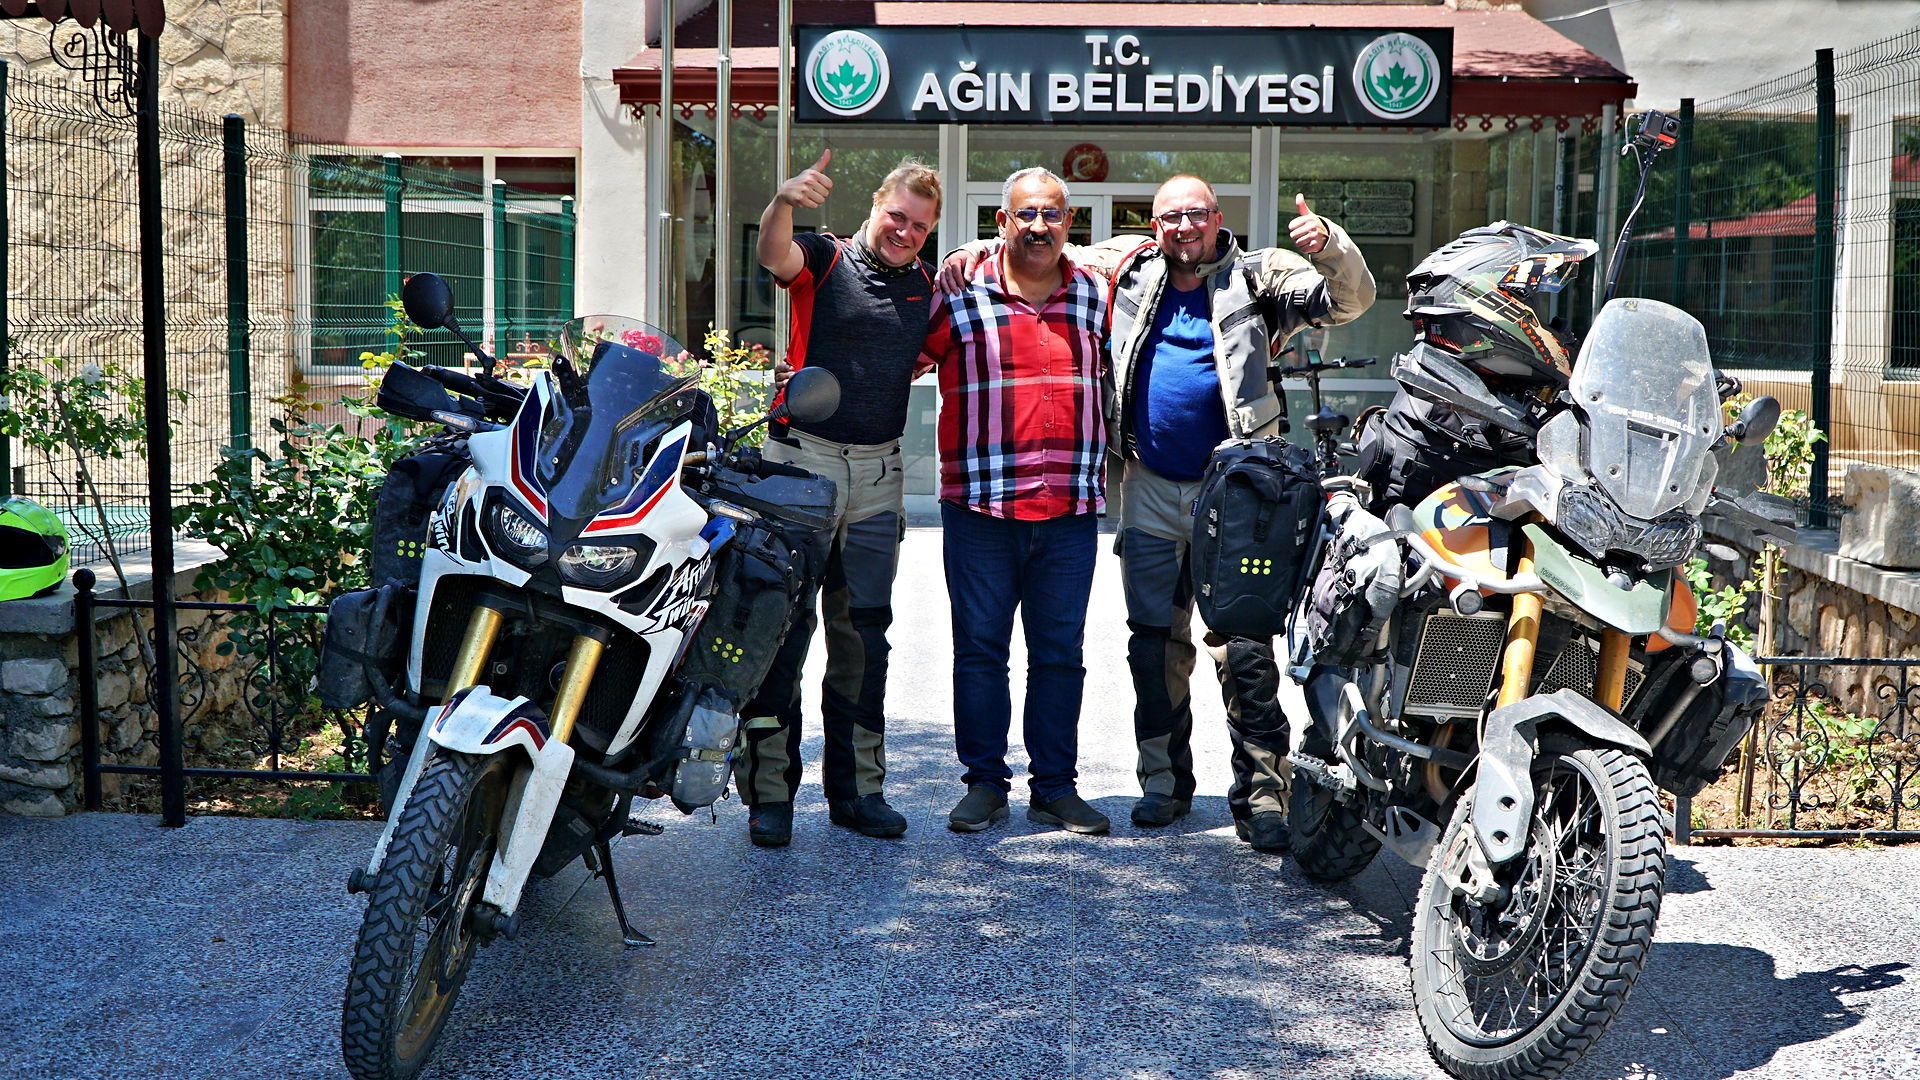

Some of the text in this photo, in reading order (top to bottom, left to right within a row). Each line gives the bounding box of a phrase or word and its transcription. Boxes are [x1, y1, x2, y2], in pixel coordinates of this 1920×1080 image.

[1085, 34, 1150, 66] T.C.
[911, 60, 1334, 113] AĞIN BELEDİYESİ
[1455, 280, 1526, 324] LS2
